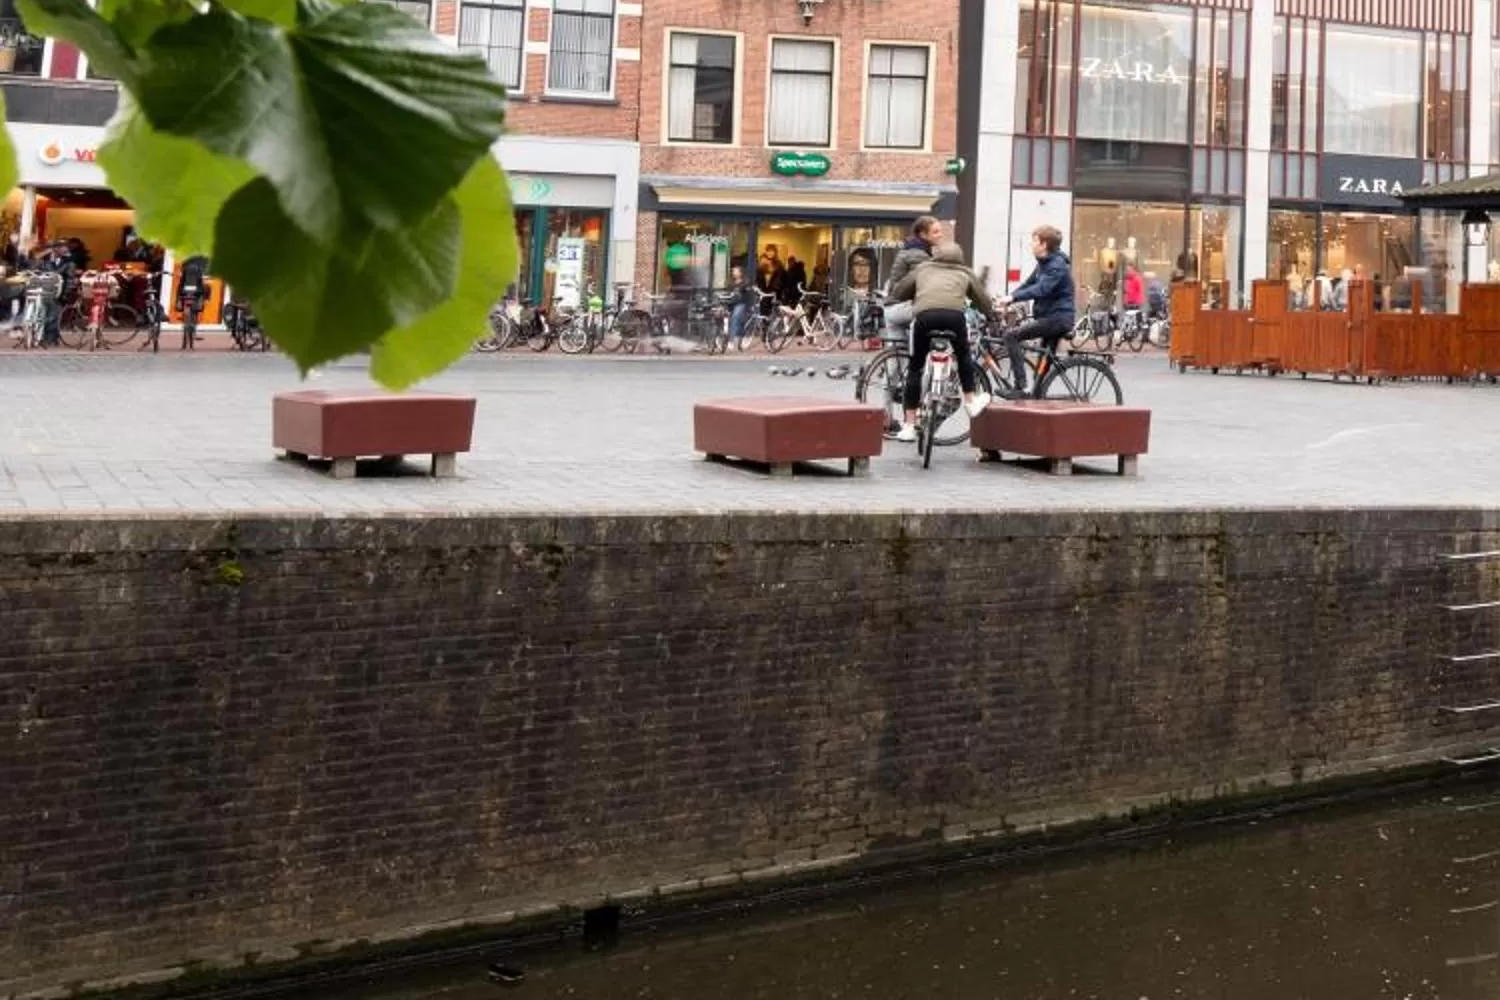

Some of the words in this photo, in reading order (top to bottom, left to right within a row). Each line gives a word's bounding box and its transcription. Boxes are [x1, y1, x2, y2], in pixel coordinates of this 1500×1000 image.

[1082, 57, 1182, 83] ZARA
[777, 157, 826, 169] Specsavers
[1339, 176, 1405, 196] ZARA
